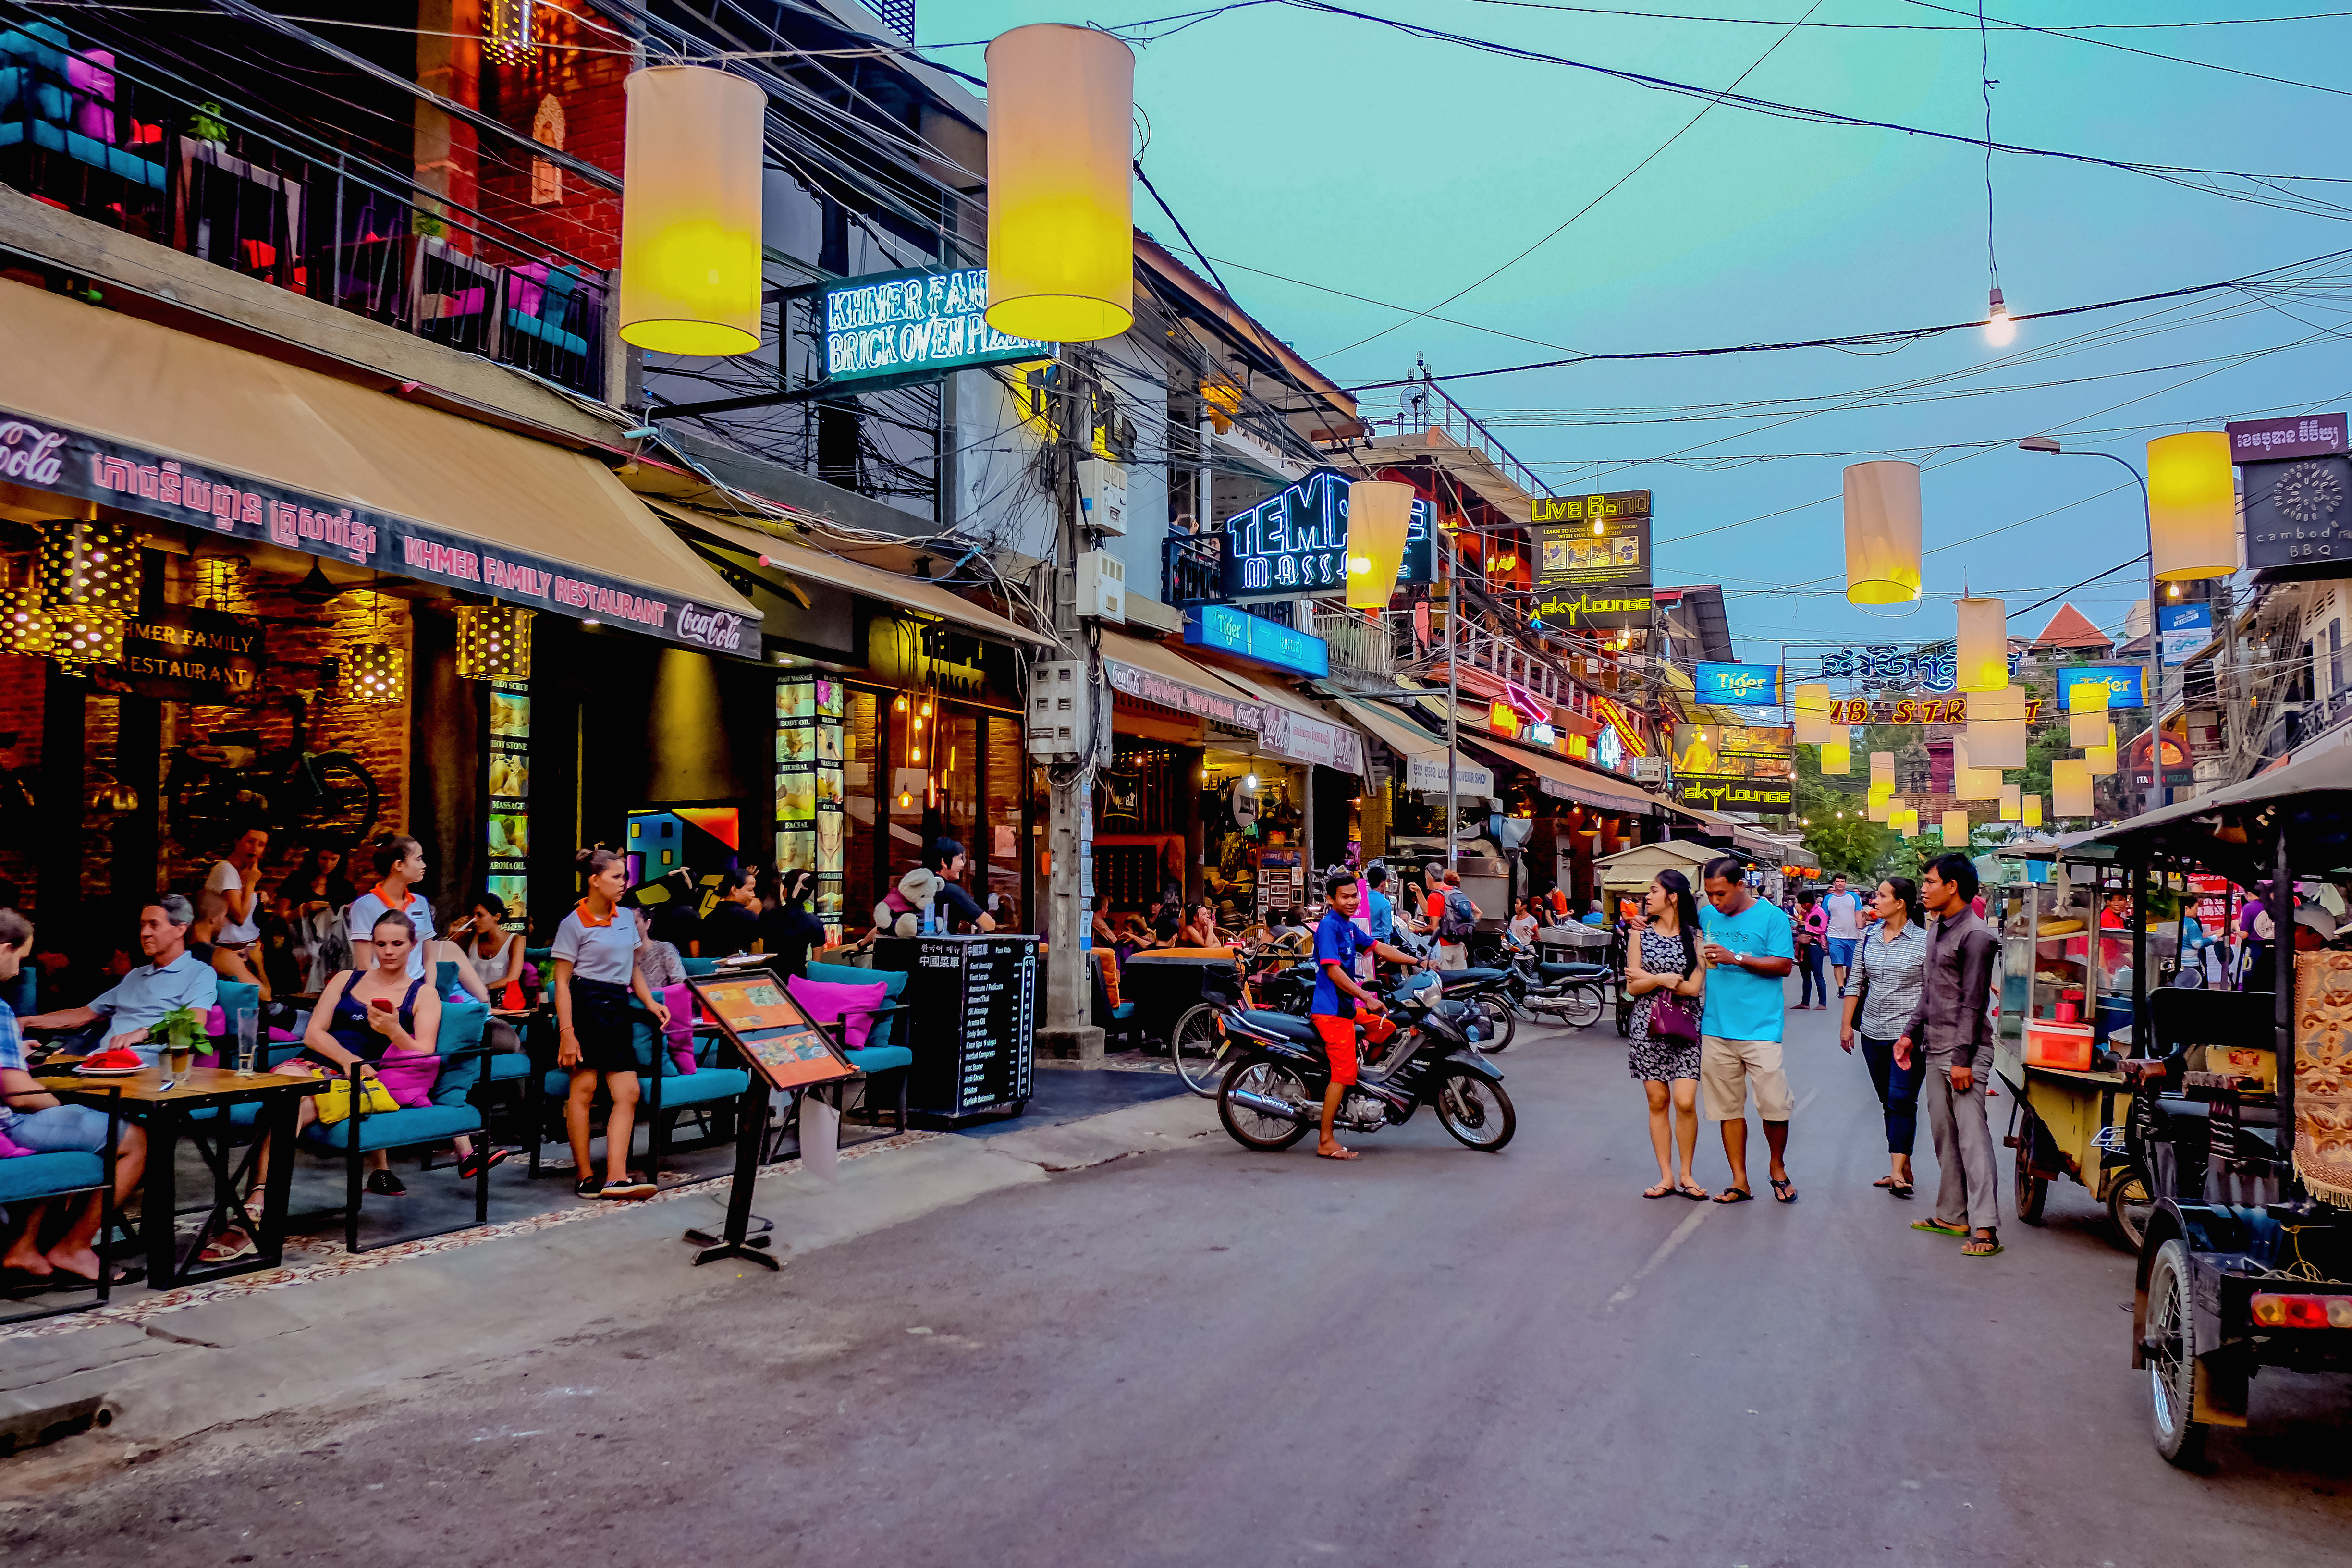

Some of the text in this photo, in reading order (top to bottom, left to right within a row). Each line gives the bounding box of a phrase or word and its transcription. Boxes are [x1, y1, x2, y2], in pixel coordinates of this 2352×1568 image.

[827, 269, 988, 331] KHMER FAM
[828, 325, 897, 373] BRICK
[899, 316, 965, 362] OVEN
[1226, 472, 1425, 557] TEMPE
[1531, 490, 1650, 522] Live Band
[2290, 544, 2331, 557] BBQ
[404, 535, 667, 628] KHMER FAMILY RESTAURANT
[124, 622, 253, 652] HMER FAMILY
[1218, 614, 1242, 646] Tiger
[1717, 672, 1767, 697] Tiger
[1829, 698, 2042, 725] UB STRT
[1438, 768, 1449, 780] LOCA
[1456, 771, 1474, 784] OUVENIR
[492, 800, 525, 810] MASSAGE
[919, 955, 960, 968] 中國菜單
[921, 944, 960, 954] 한국어 메뉴
